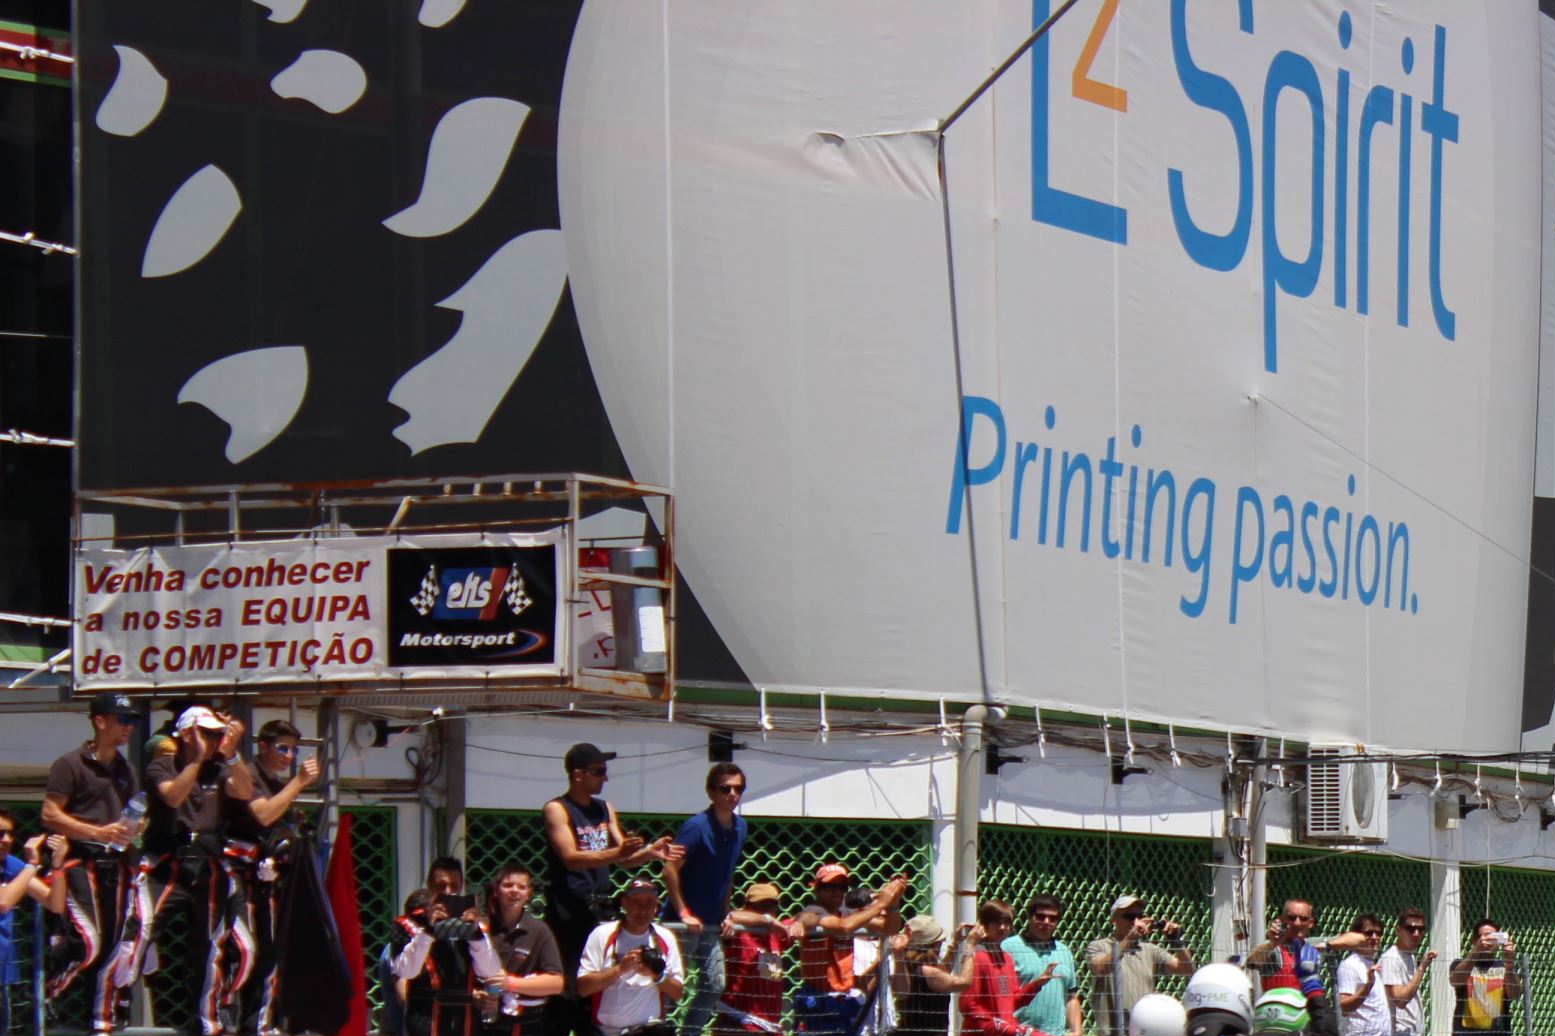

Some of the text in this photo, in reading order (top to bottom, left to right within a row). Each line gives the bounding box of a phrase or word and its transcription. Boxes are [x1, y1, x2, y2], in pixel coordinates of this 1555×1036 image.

[1167, 0, 1459, 374] Spirit
[945, 395, 1418, 624] Printing passion.
[84, 558, 370, 594] Venha conhecer
[84, 595, 370, 632] a nossa EQUIPA
[82, 632, 373, 675] de COMPETIÇÃO
[400, 631, 516, 648] Motorsport
